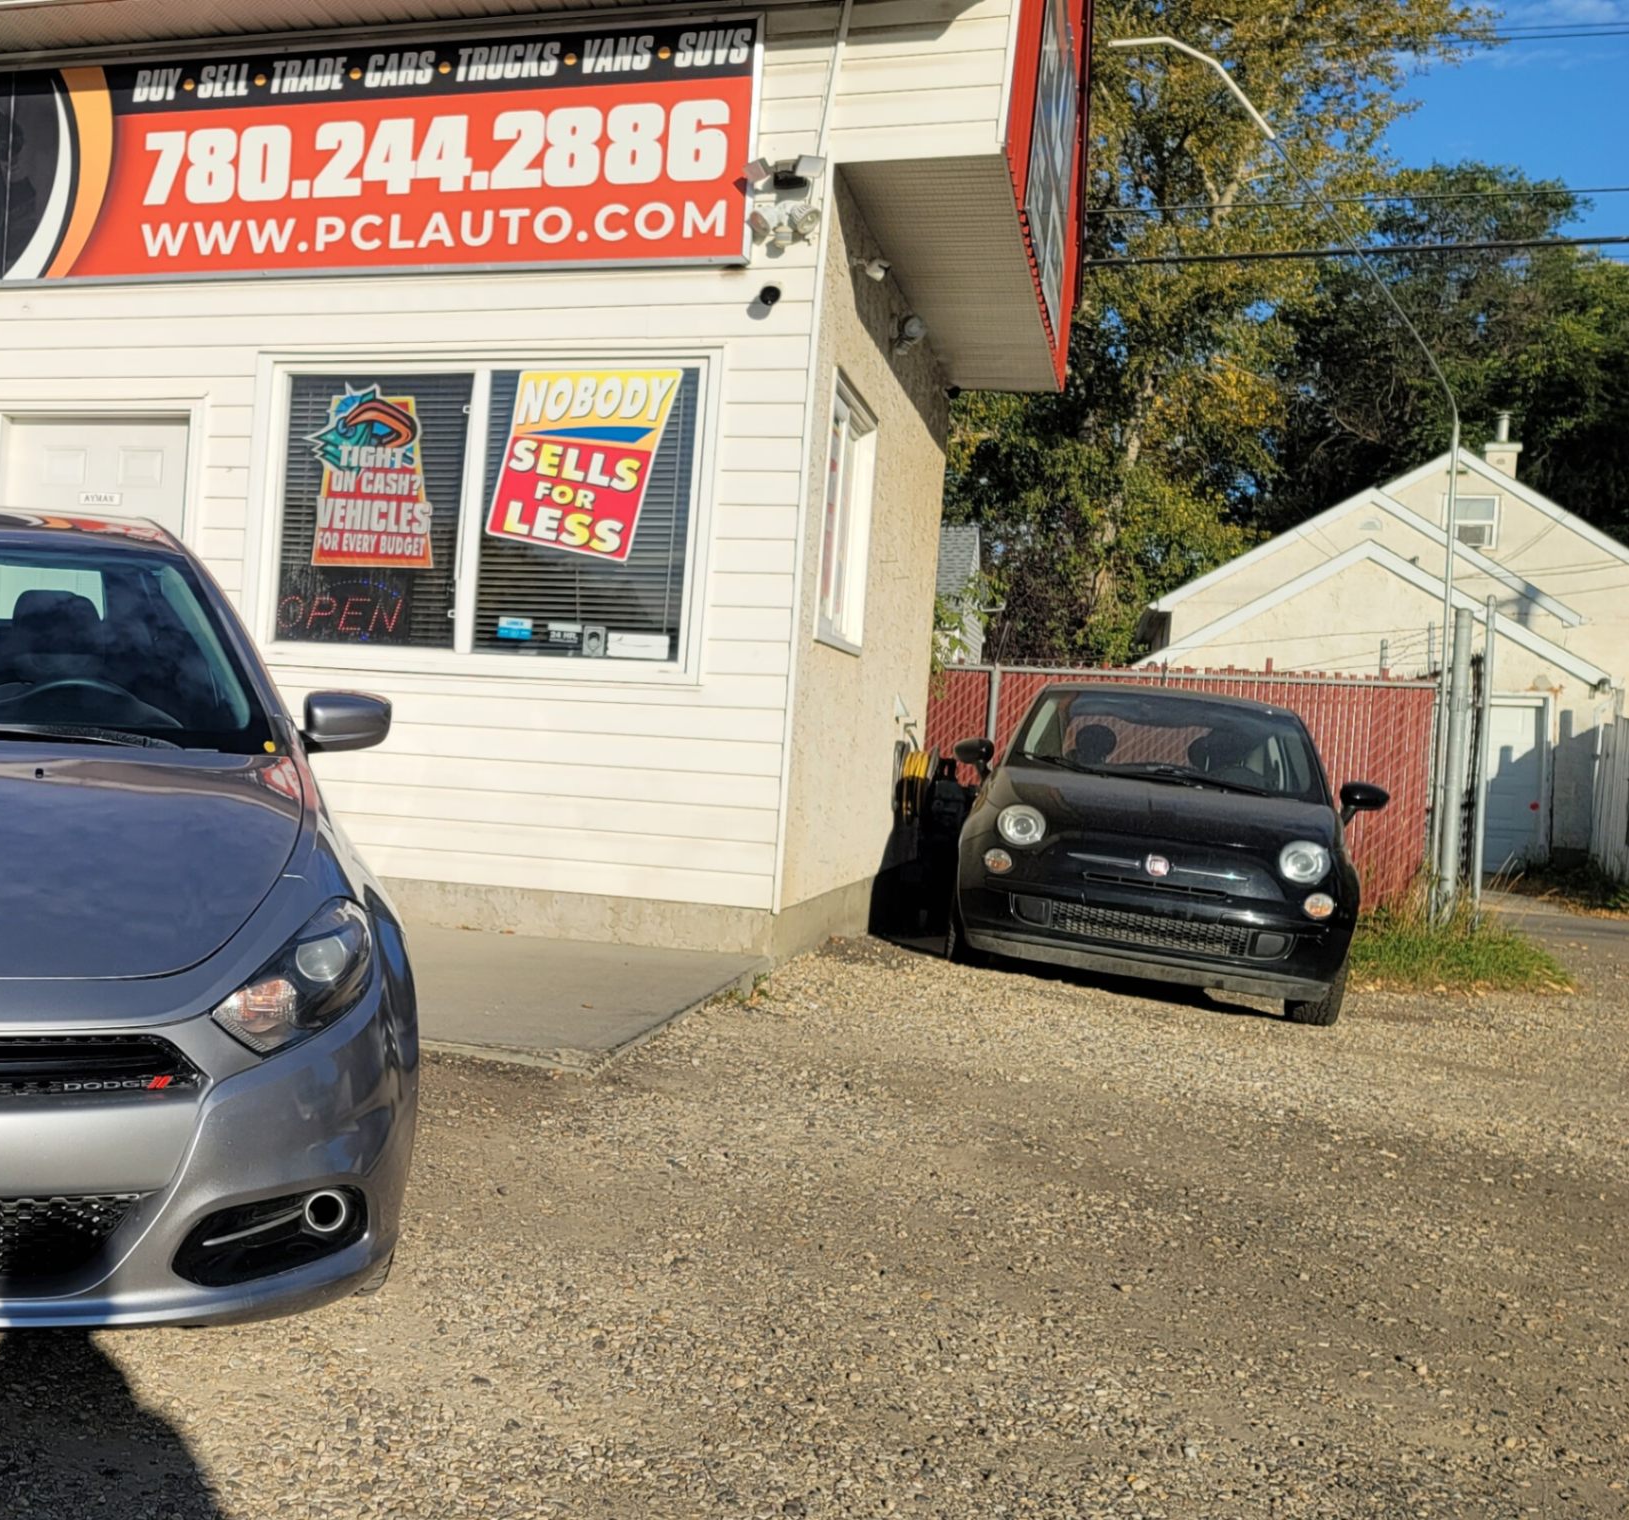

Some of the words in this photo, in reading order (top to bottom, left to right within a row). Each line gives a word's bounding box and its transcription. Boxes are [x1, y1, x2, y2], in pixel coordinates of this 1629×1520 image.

[132, 68, 182, 103] BUY
[197, 63, 249, 99] SELL
[270, 56, 348, 94] TRADE
[364, 50, 436, 88] CARS
[455, 41, 561, 82] TRUCKS
[582, 35, 654, 74] VANS
[674, 28, 753, 68] SUVS
[142, 98, 731, 206] 780.244.2886
[140, 199, 727, 258] WWW.PCLAUTO.COM
[517, 376, 676, 425] NOBODY
[338, 444, 405, 469] TIGHT
[508, 439, 642, 492] SELLS
[331, 470, 357, 493] ON
[361, 471, 421, 496] CASH?
[534, 480, 596, 511] FOR
[316, 496, 432, 535] VEHICLES
[503, 500, 624, 553] LESS
[318, 531, 340, 551] FOR
[342, 533, 378, 553] EVERY
[379, 535, 426, 557] BUDGET
[276, 595, 404, 633] OPEN
